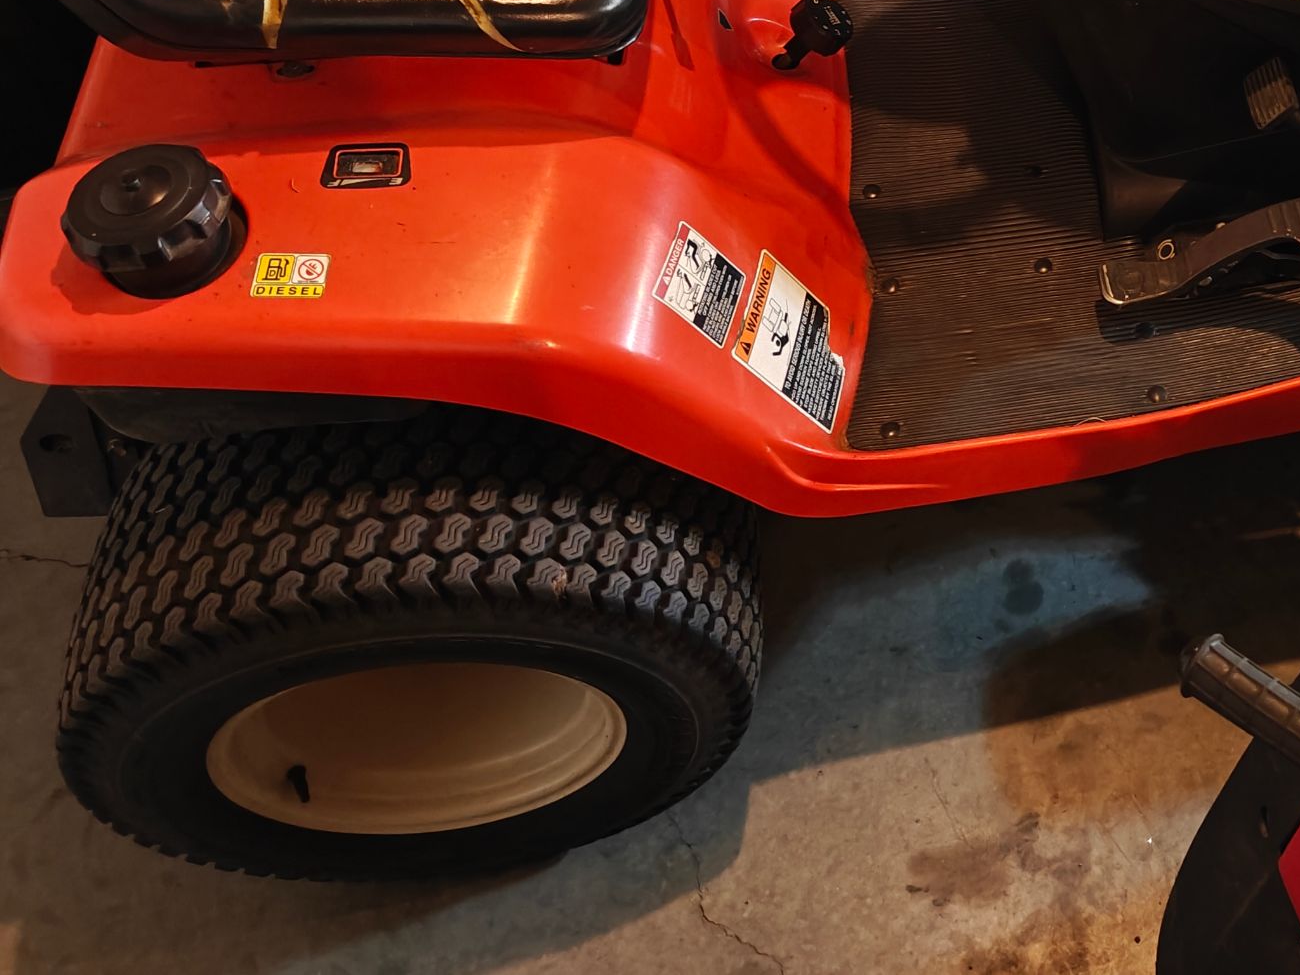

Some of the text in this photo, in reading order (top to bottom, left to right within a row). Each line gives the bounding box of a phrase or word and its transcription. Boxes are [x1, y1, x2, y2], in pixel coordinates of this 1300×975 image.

[665, 237, 684, 276] DANGER
[255, 286, 321, 296] DIESEL
[748, 266, 769, 335] WARNING
[784, 298, 811, 390] TO AVOID SERIOUS INJURY OR DEATH
